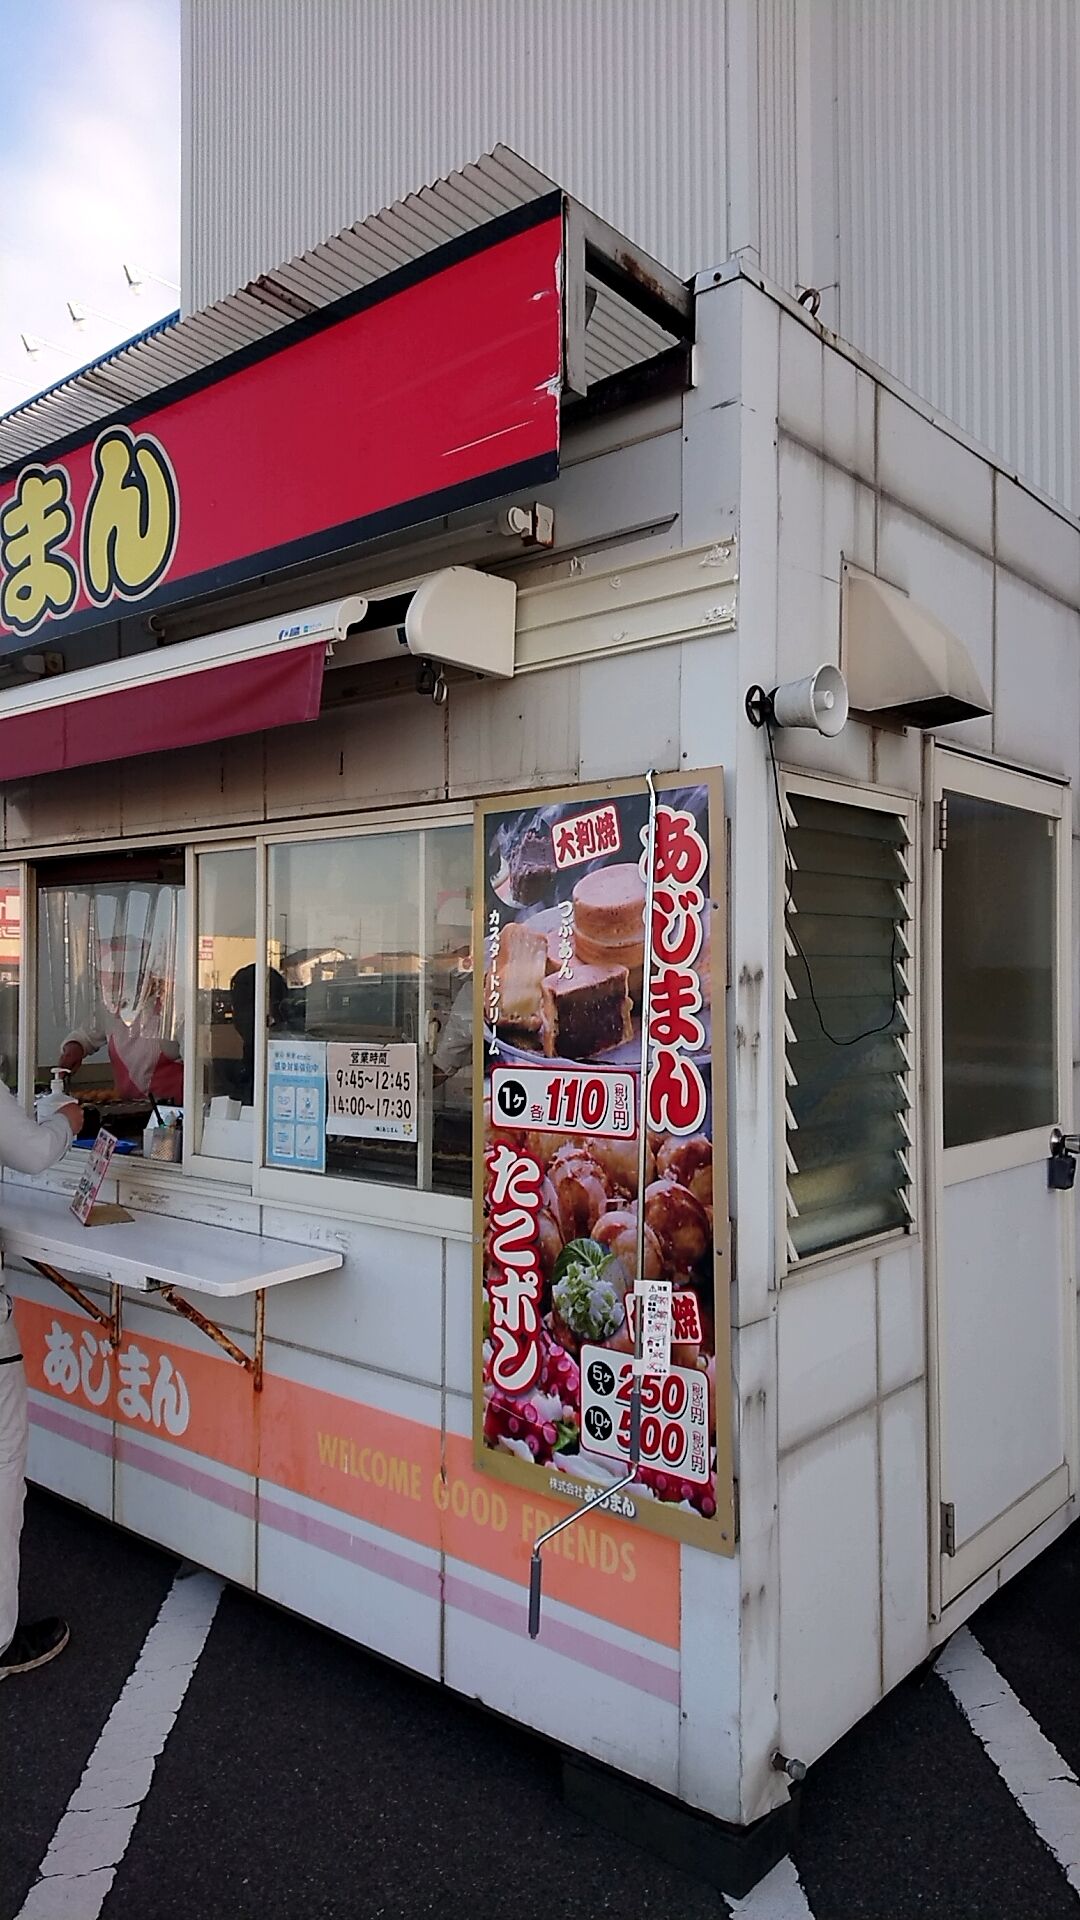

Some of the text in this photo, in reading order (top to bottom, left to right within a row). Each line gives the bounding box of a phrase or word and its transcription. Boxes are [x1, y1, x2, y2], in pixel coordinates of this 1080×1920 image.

[2, 428, 178, 634] まん
[556, 812, 617, 862] 大判焼
[488, 909, 501, 1056] カスタードクリーム
[557, 900, 575, 980] つぶあん
[641, 808, 706, 1132] あじまん
[350, 1051, 388, 1064] 営業時間
[546, 1077, 608, 1129] 110
[489, 1145, 540, 1390] たこポン
[43, 1320, 190, 1436] あじまん
[317, 1432, 637, 1583] WELCOME GOOD FRIENDS
